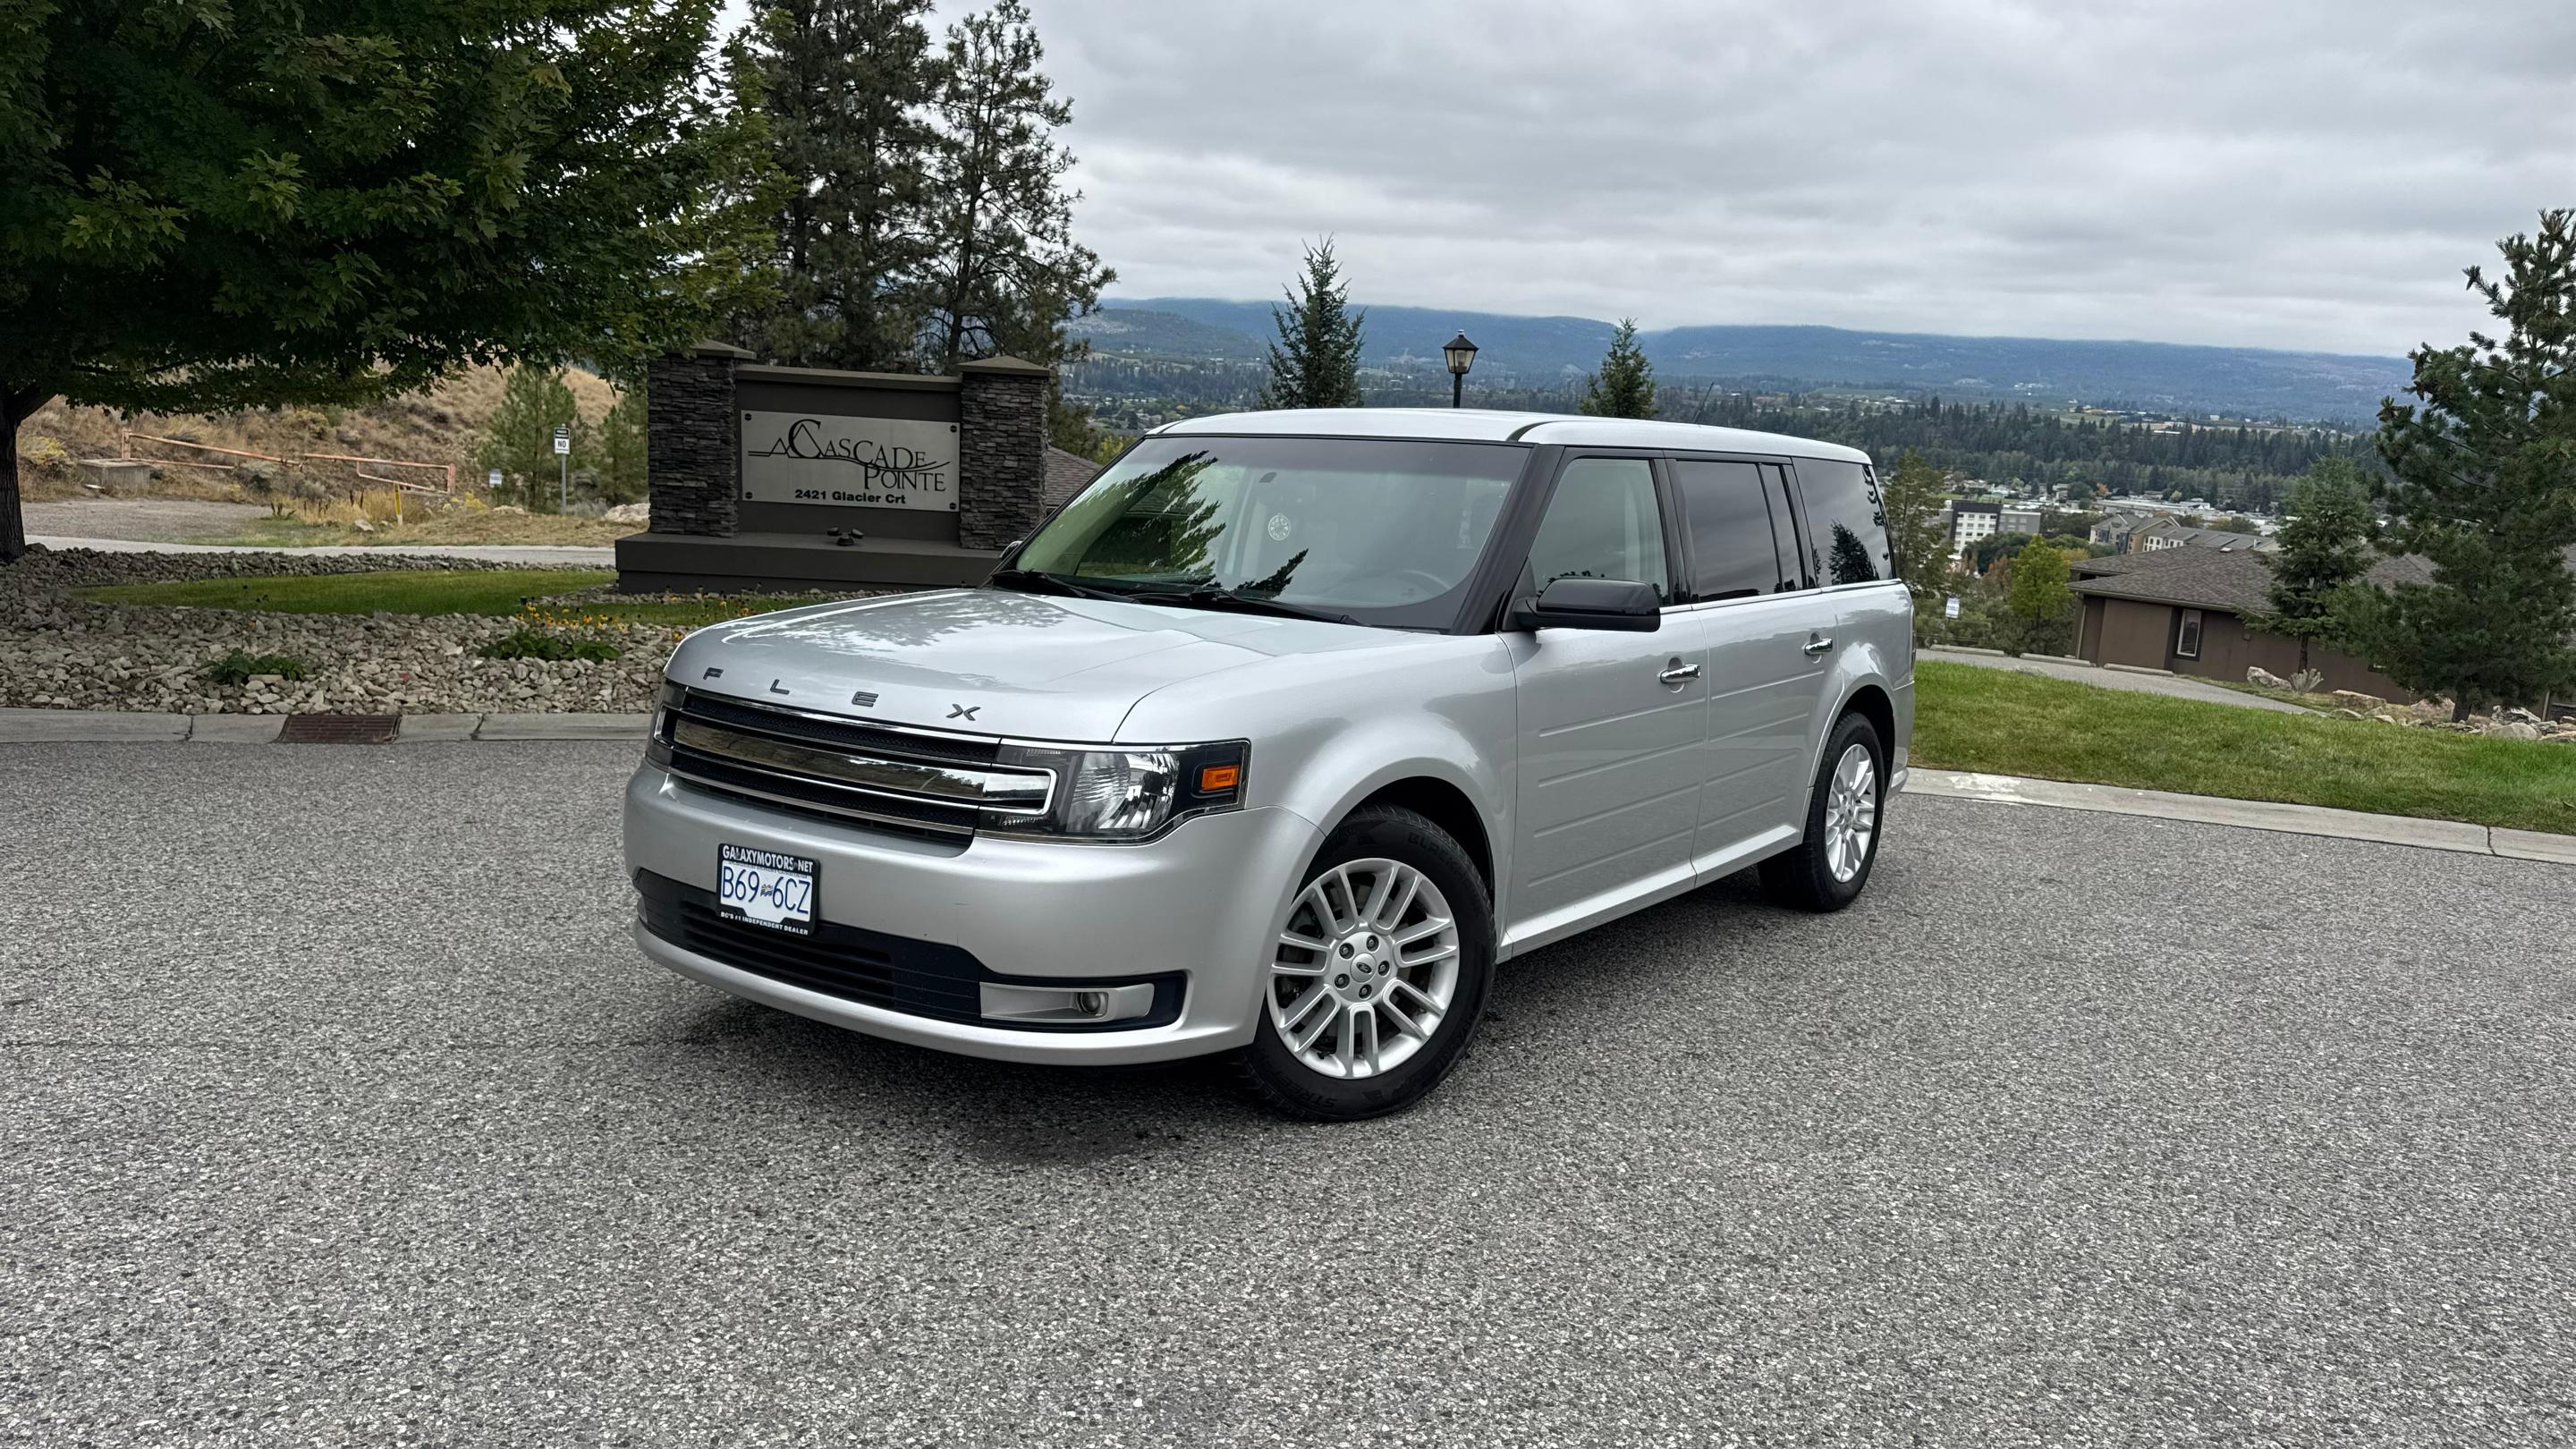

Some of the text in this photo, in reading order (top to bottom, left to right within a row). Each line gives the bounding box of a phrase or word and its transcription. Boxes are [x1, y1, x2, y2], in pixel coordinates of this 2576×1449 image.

[788, 419, 927, 470] CASCADE
[864, 463, 946, 492] POINTE
[794, 488, 906, 504] 2421 Glacier Crt
[741, 916, 784, 930] INDEPENDENT
[784, 925, 809, 936] DEALER
